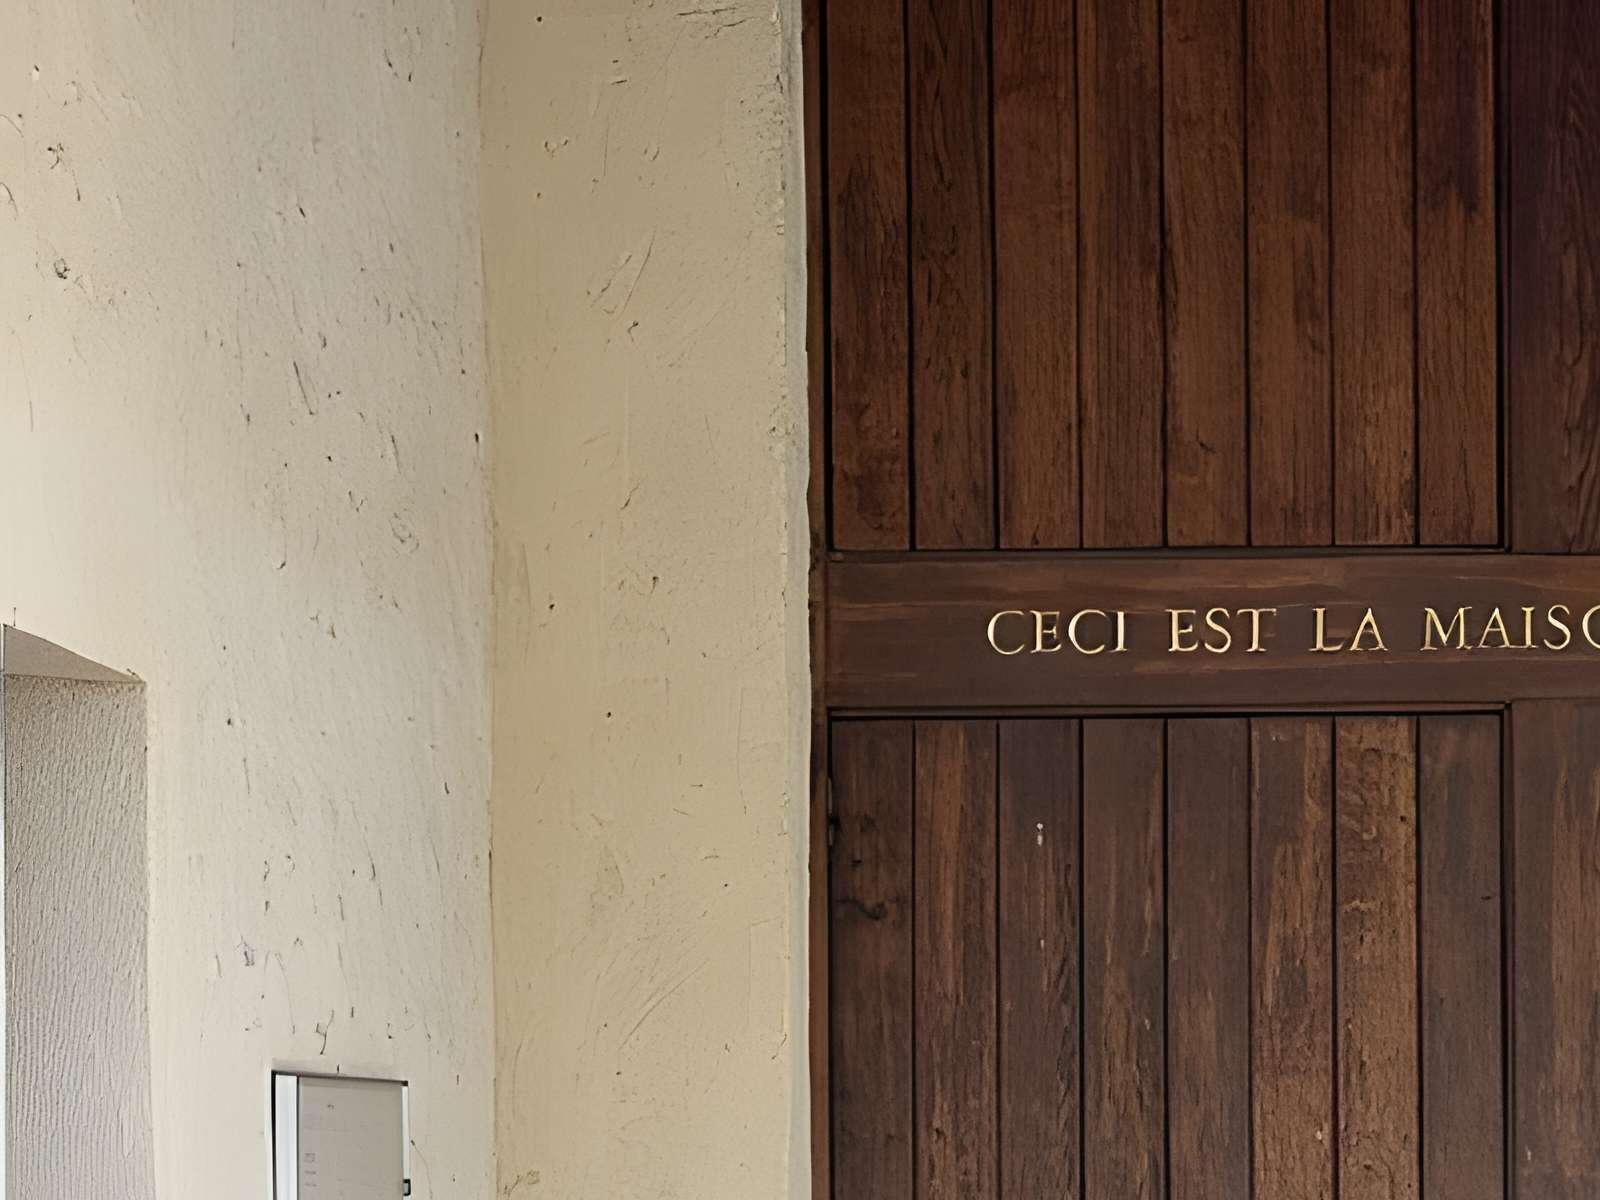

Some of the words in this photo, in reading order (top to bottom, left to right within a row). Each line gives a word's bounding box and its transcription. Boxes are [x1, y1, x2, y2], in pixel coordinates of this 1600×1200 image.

[986, 609, 1128, 654] CECI
[1165, 607, 1277, 653] EST
[1308, 607, 1389, 652] LA
